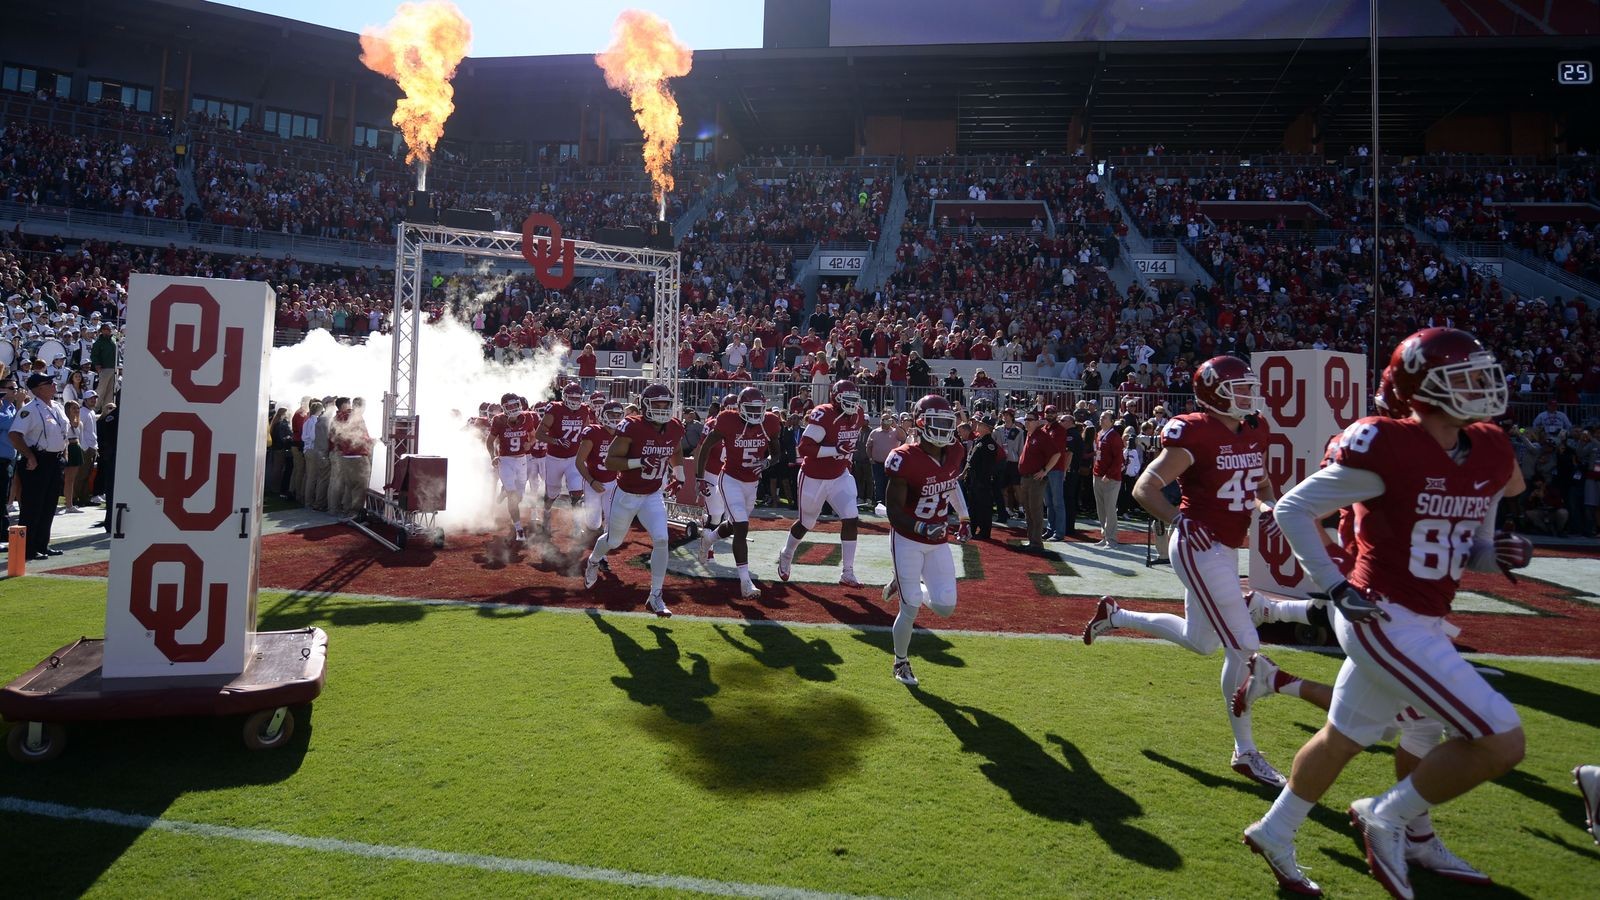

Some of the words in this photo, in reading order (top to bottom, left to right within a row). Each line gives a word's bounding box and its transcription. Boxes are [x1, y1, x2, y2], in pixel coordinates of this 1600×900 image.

[1564, 64, 1587, 80] 25
[522, 213, 575, 289] OU
[828, 257, 860, 269] 42/43
[147, 284, 244, 404] OU
[611, 354, 624, 365] 42
[1004, 365, 1019, 376] 43
[1260, 356, 1306, 428] OU
[1324, 356, 1359, 430] OU
[1104, 399, 1114, 408] 10
[561, 426, 582, 443] 77
[734, 438, 766, 448] SOONERS
[510, 437, 521, 452] 9
[641, 446, 675, 456] SOONERS
[741, 448, 759, 468] 5
[1215, 452, 1264, 470] SOONERS
[138, 411, 237, 532] OU
[1216, 468, 1264, 512] 45
[1415, 492, 1490, 518] SOONERS
[1407, 518, 1483, 582] 88
[129, 543, 229, 663] OU
